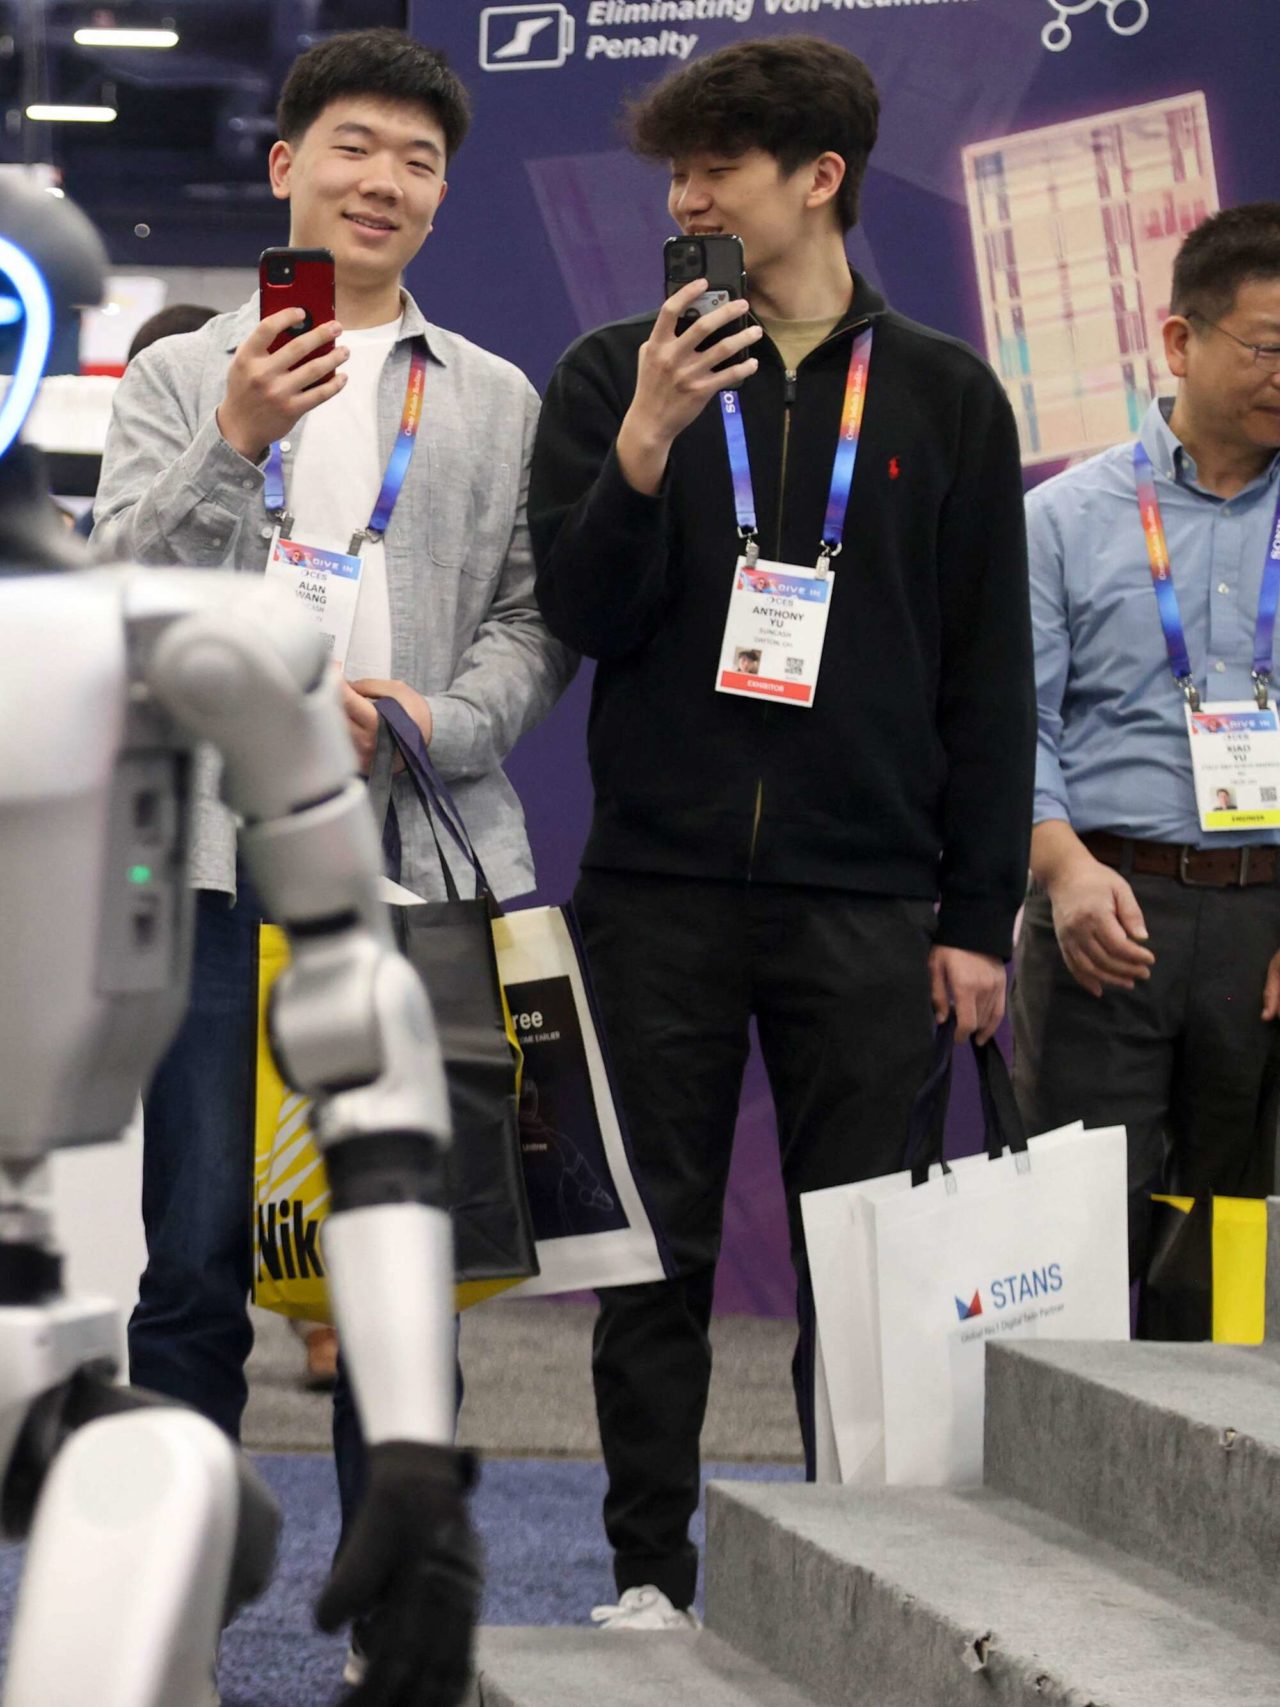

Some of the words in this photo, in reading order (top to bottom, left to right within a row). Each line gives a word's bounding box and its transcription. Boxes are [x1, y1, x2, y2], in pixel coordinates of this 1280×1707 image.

[586, 0, 756, 26] Eliminating
[585, 30, 699, 60] Penalty
[723, 391, 736, 414] SO
[312, 558, 339, 570] DIVE
[342, 564, 354, 574] IN
[295, 589, 327, 605] WANG
[298, 581, 326, 594] ALAN
[752, 606, 805, 621] ANTHONY
[770, 618, 785, 628] YU
[512, 1010, 543, 1030] ree
[258, 1198, 325, 1283] Nik
[990, 1263, 1063, 1309] STANS
